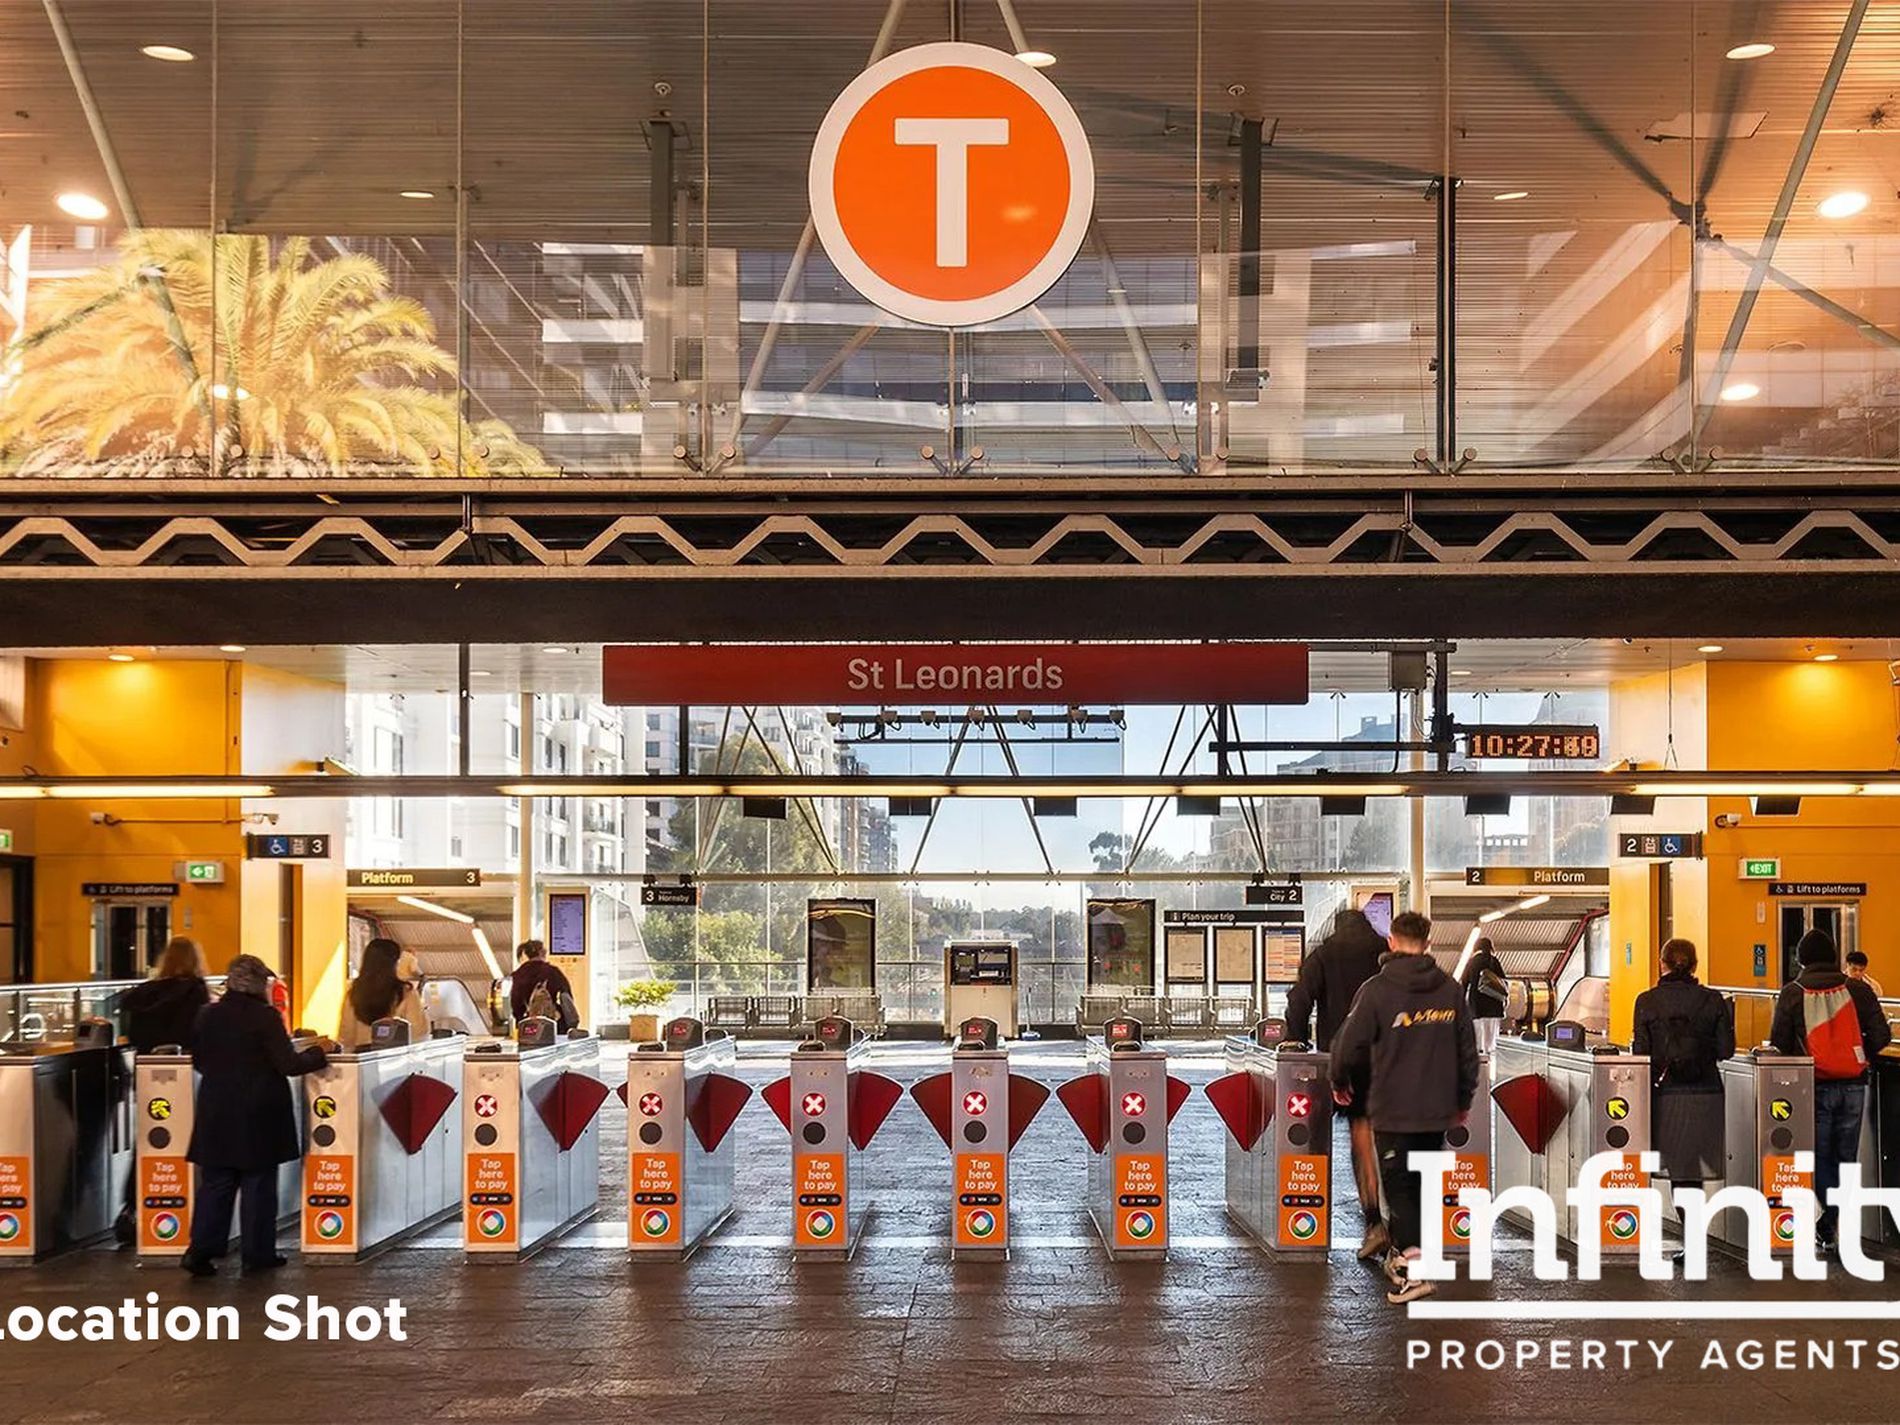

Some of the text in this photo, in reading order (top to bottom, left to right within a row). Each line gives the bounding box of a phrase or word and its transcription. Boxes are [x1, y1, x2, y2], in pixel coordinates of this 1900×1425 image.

[895, 118, 1009, 267] T
[848, 657, 1063, 690] St Leonards
[312, 838, 323, 854] 3
[1627, 838, 1637, 852] 2
[1754, 863, 1772, 874] EXIT
[361, 871, 475, 884] Platform 3
[1472, 870, 1585, 882] 2 Platform
[125, 886, 134, 894] to
[134, 885, 173, 895] platforms
[1288, 889, 1298, 901] 2
[1796, 885, 1861, 894] Lift to platforms
[646, 890, 655, 901] 3
[1182, 912, 1236, 922] Plan your trip
[155, 1162, 175, 1172] Tap
[319, 1160, 340, 1171] Tap
[481, 1158, 501, 1169] Tap
[646, 1158, 666, 1169] Tap
[810, 1160, 830, 1171] Tap
[970, 1159, 990, 1170] Tap
[1130, 1160, 1150, 1171] Tap
[1294, 1160, 1313, 1172] Tap
[152, 1172, 177, 1181] here
[317, 1170, 342, 1180] here
[479, 1168, 503, 1179] here
[644, 1168, 668, 1178] here
[808, 1169, 832, 1180] here
[968, 1169, 993, 1179] here
[1128, 1170, 1152, 1180] here
[1291, 1170, 1316, 1181] here
[1451, 1170, 1476, 1180] here
[1611, 1170, 1635, 1180] here
[1775, 1172, 1799, 1182] here
[149, 1183, 182, 1194] to pay
[313, 1181, 346, 1192] to pay
[475, 1180, 508, 1191] to pay
[640, 1179, 672, 1191] to pay
[804, 1181, 837, 1191] to pay
[964, 1180, 997, 1191] to pay
[1124, 1181, 1157, 1192] to pay
[1287, 1181, 1320, 1193] to pay
[1448, 1181, 1459, 1190] to
[1771, 1183, 1782, 1192] to
